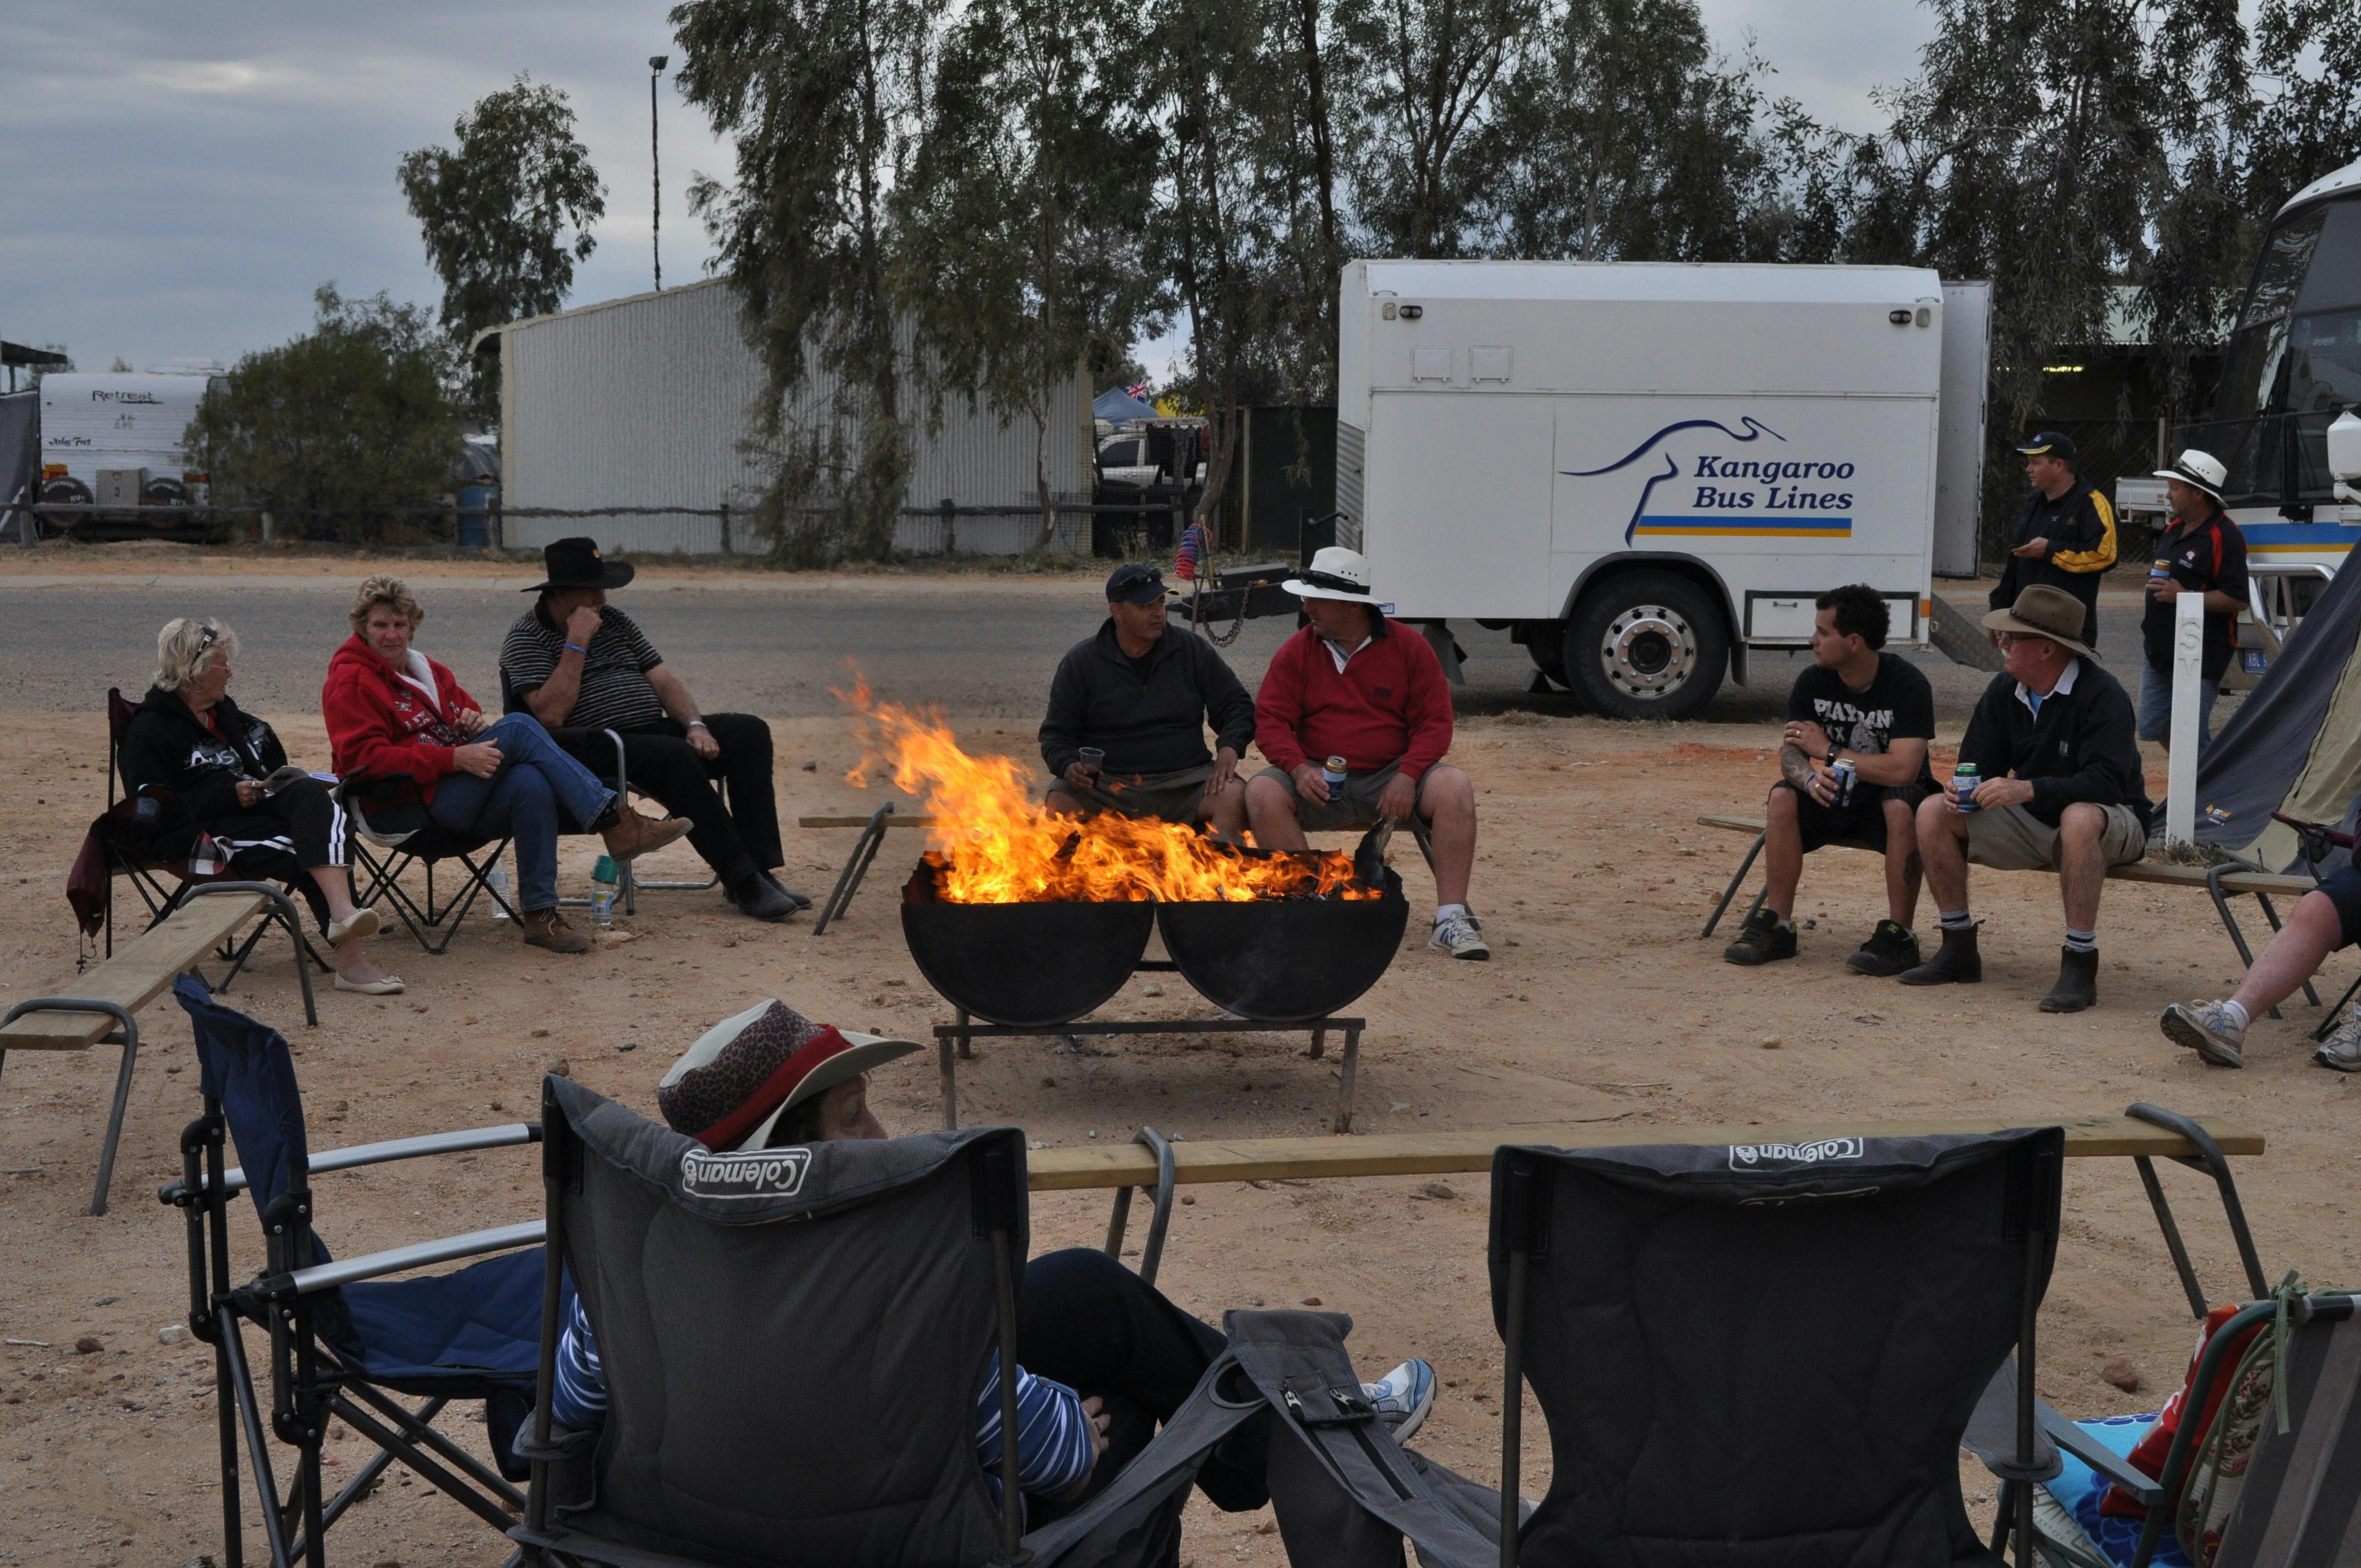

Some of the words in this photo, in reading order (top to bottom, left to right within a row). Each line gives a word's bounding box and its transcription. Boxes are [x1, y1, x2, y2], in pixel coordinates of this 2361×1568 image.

[93, 390, 153, 401] Retreat
[1693, 455, 1855, 484] Kangaroo
[1692, 486, 1755, 509] Bus
[1765, 485, 1854, 510] Lines
[1759, 1139, 1855, 1163] Coleman
[698, 1159, 797, 1190] Coleman
